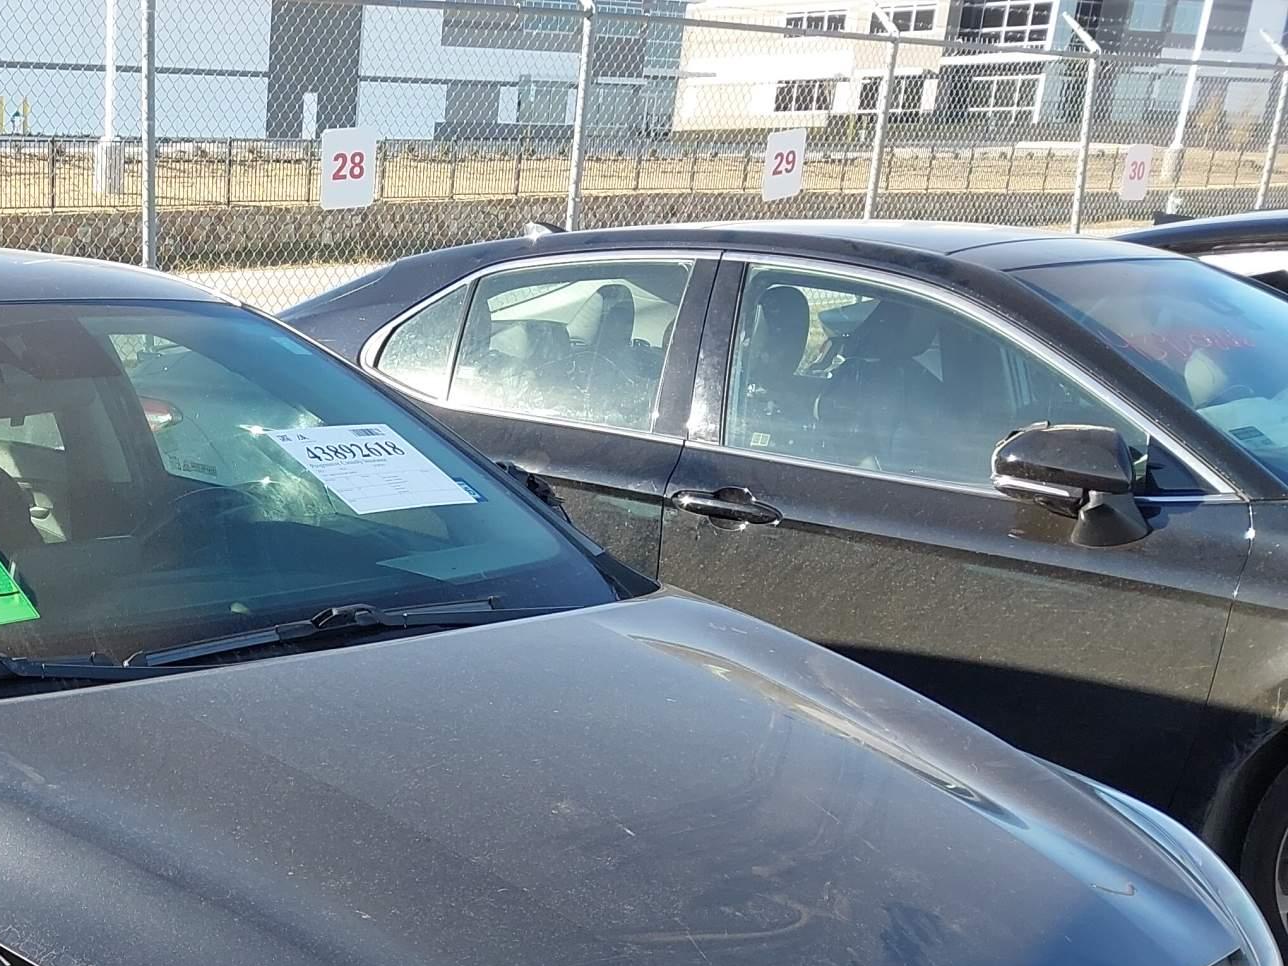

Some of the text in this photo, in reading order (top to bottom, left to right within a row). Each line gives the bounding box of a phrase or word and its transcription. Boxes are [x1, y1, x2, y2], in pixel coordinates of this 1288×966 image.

[332, 152, 365, 180] 28
[772, 150, 797, 176] 29
[1129, 161, 1145, 180] 30
[305, 441, 405, 462] 43892618
